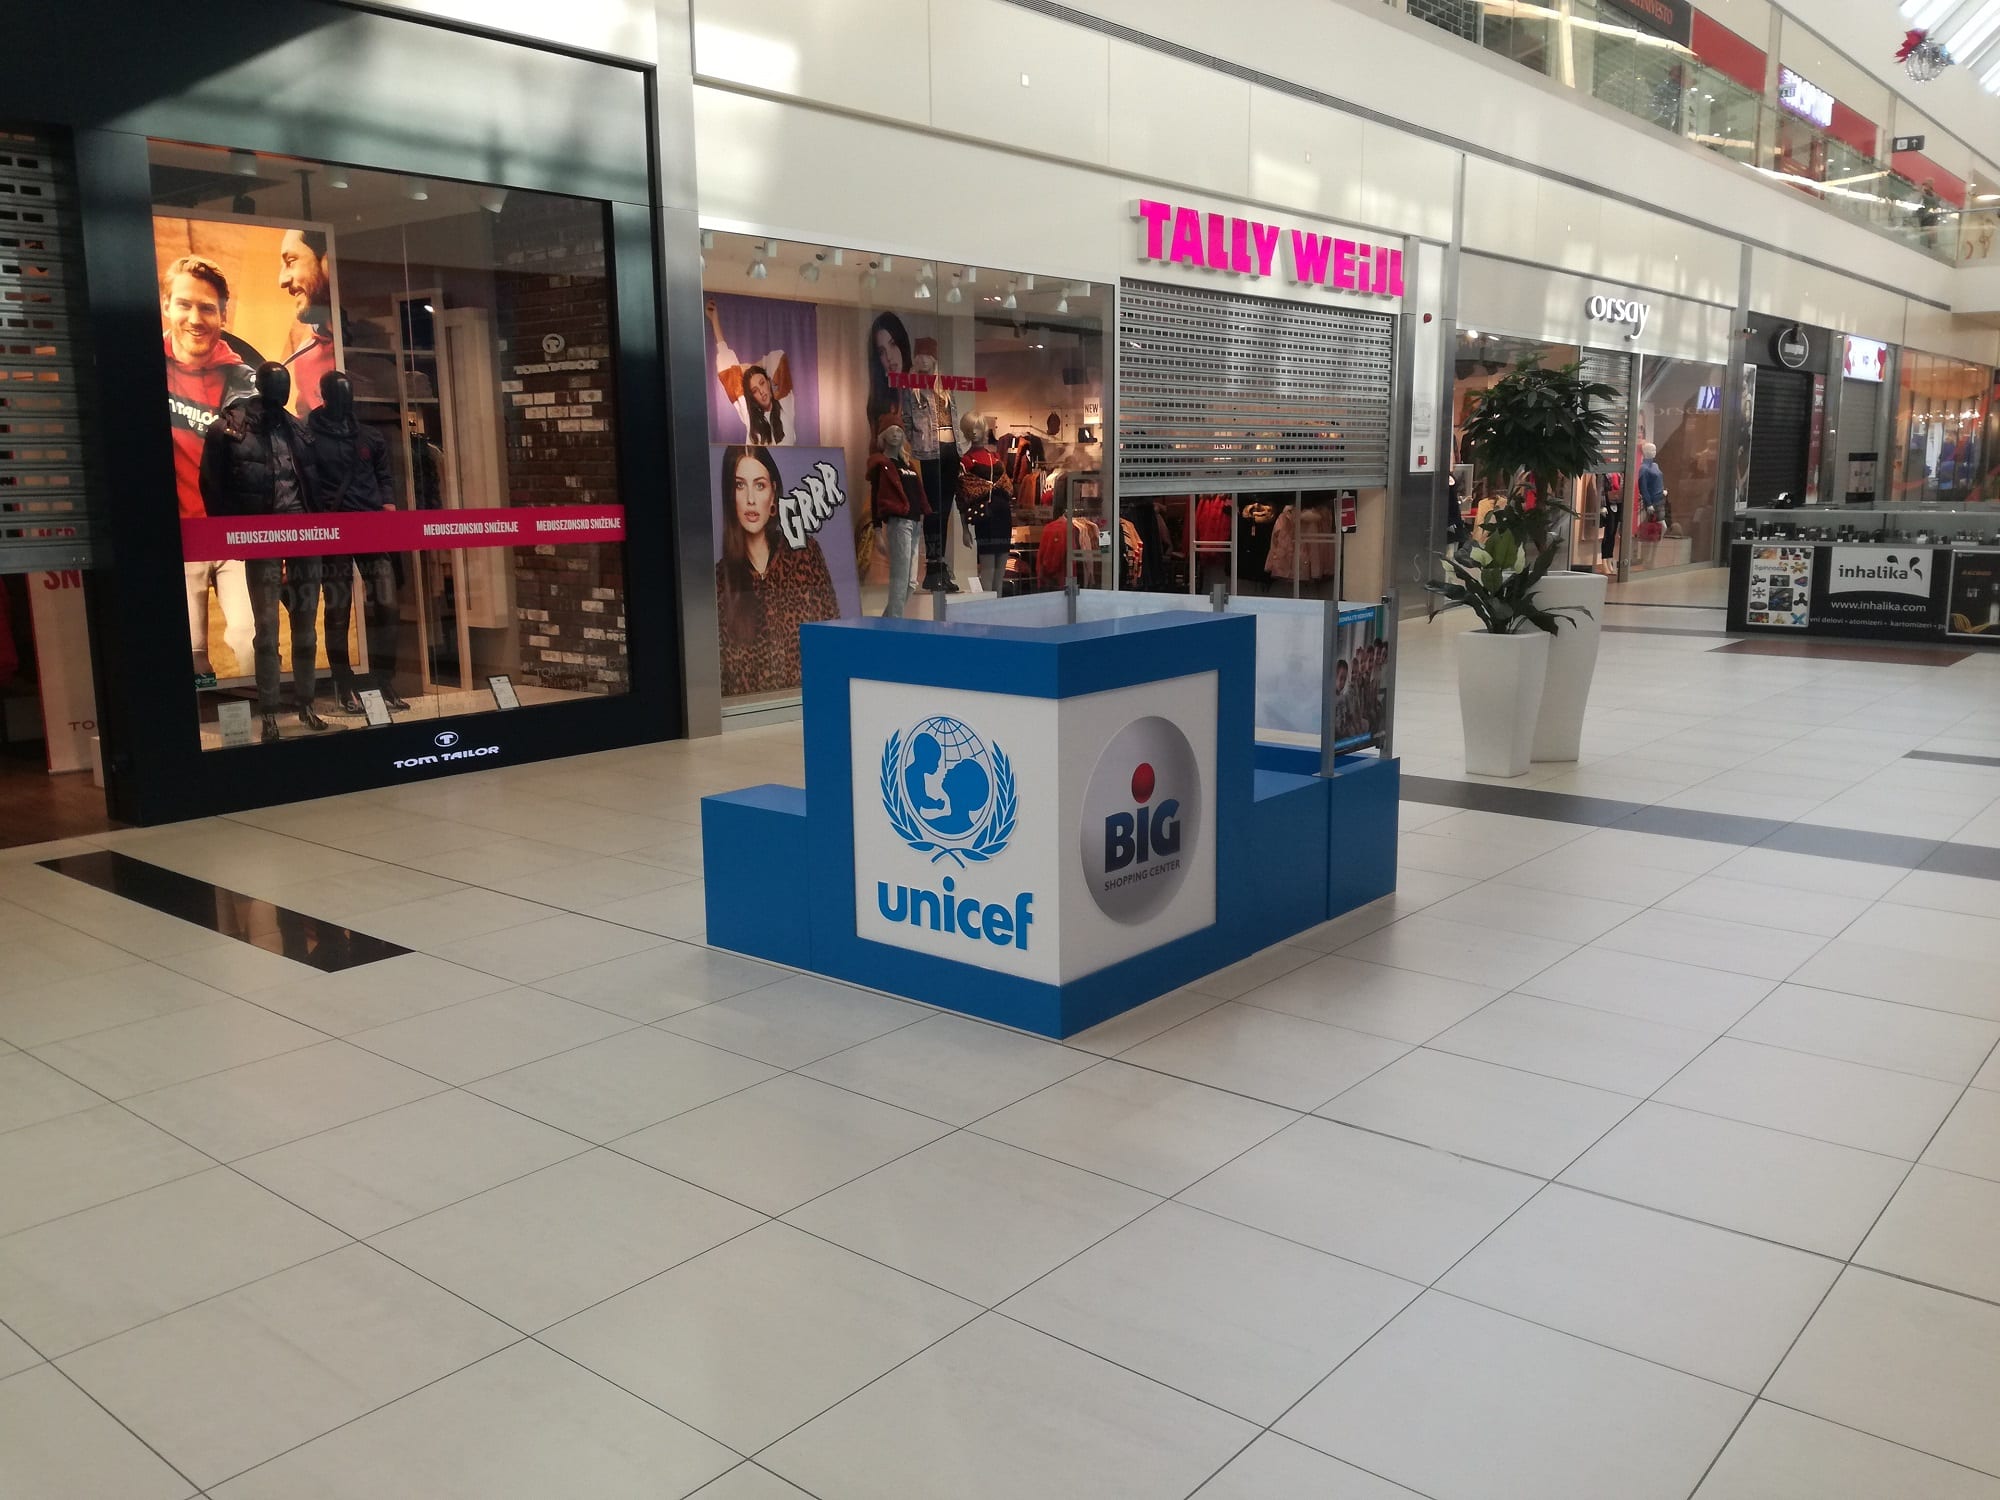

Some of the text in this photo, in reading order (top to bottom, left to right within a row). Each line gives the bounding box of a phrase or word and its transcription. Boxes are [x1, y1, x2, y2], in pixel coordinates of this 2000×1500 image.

[1139, 198, 1280, 277] TALLY
[1590, 294, 1651, 340] orsay
[887, 372, 937, 390] TALLY
[1084, 403, 1099, 414] NEW
[778, 461, 846, 550] GRRR
[484, 519, 520, 533] SNIŽENJE
[590, 515, 622, 529] SNIŽENJE
[299, 526, 341, 541] SNIŽENJE
[1839, 565, 1908, 580] inhalika
[1831, 600, 1927, 612] www.inhalika.com
[394, 745, 499, 769] TOM TAILOR
[1105, 798, 1181, 873] BIG
[1104, 859, 1181, 892] SHOPPING CENTER
[877, 875, 1033, 951] unicef
